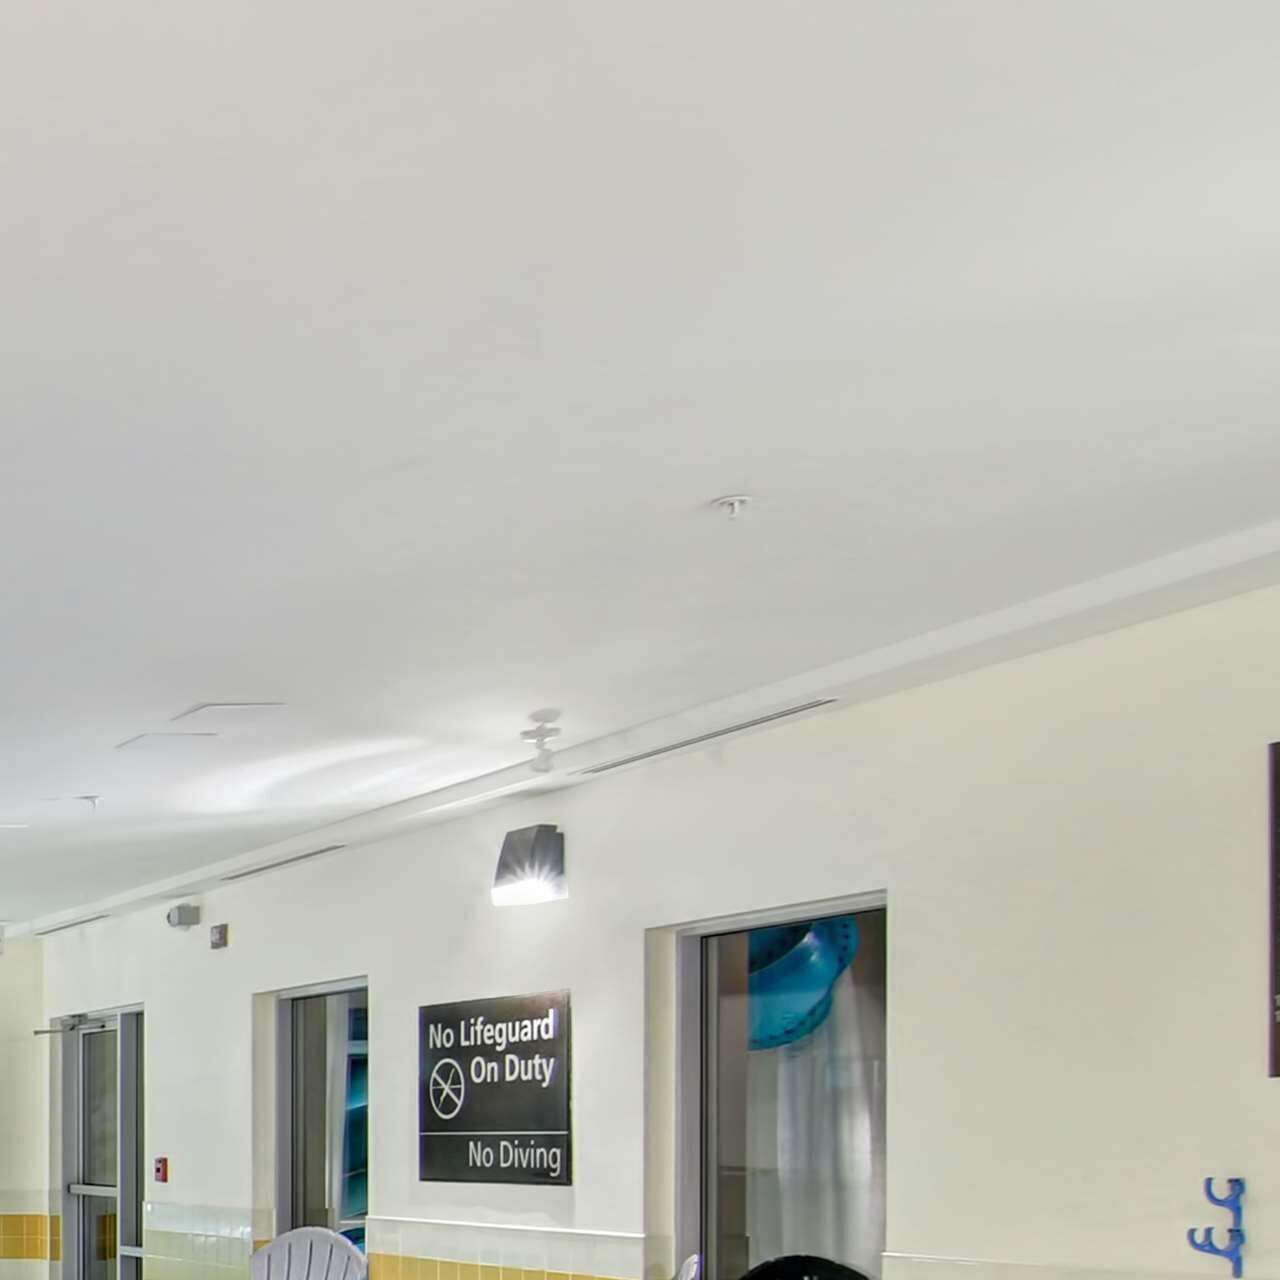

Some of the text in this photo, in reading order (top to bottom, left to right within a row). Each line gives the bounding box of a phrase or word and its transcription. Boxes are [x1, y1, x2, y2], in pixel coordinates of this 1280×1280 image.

[429, 1008, 555, 1051] No Lifeguard
[470, 1054, 555, 1087] On Duty
[468, 1139, 561, 1176] No Diving
